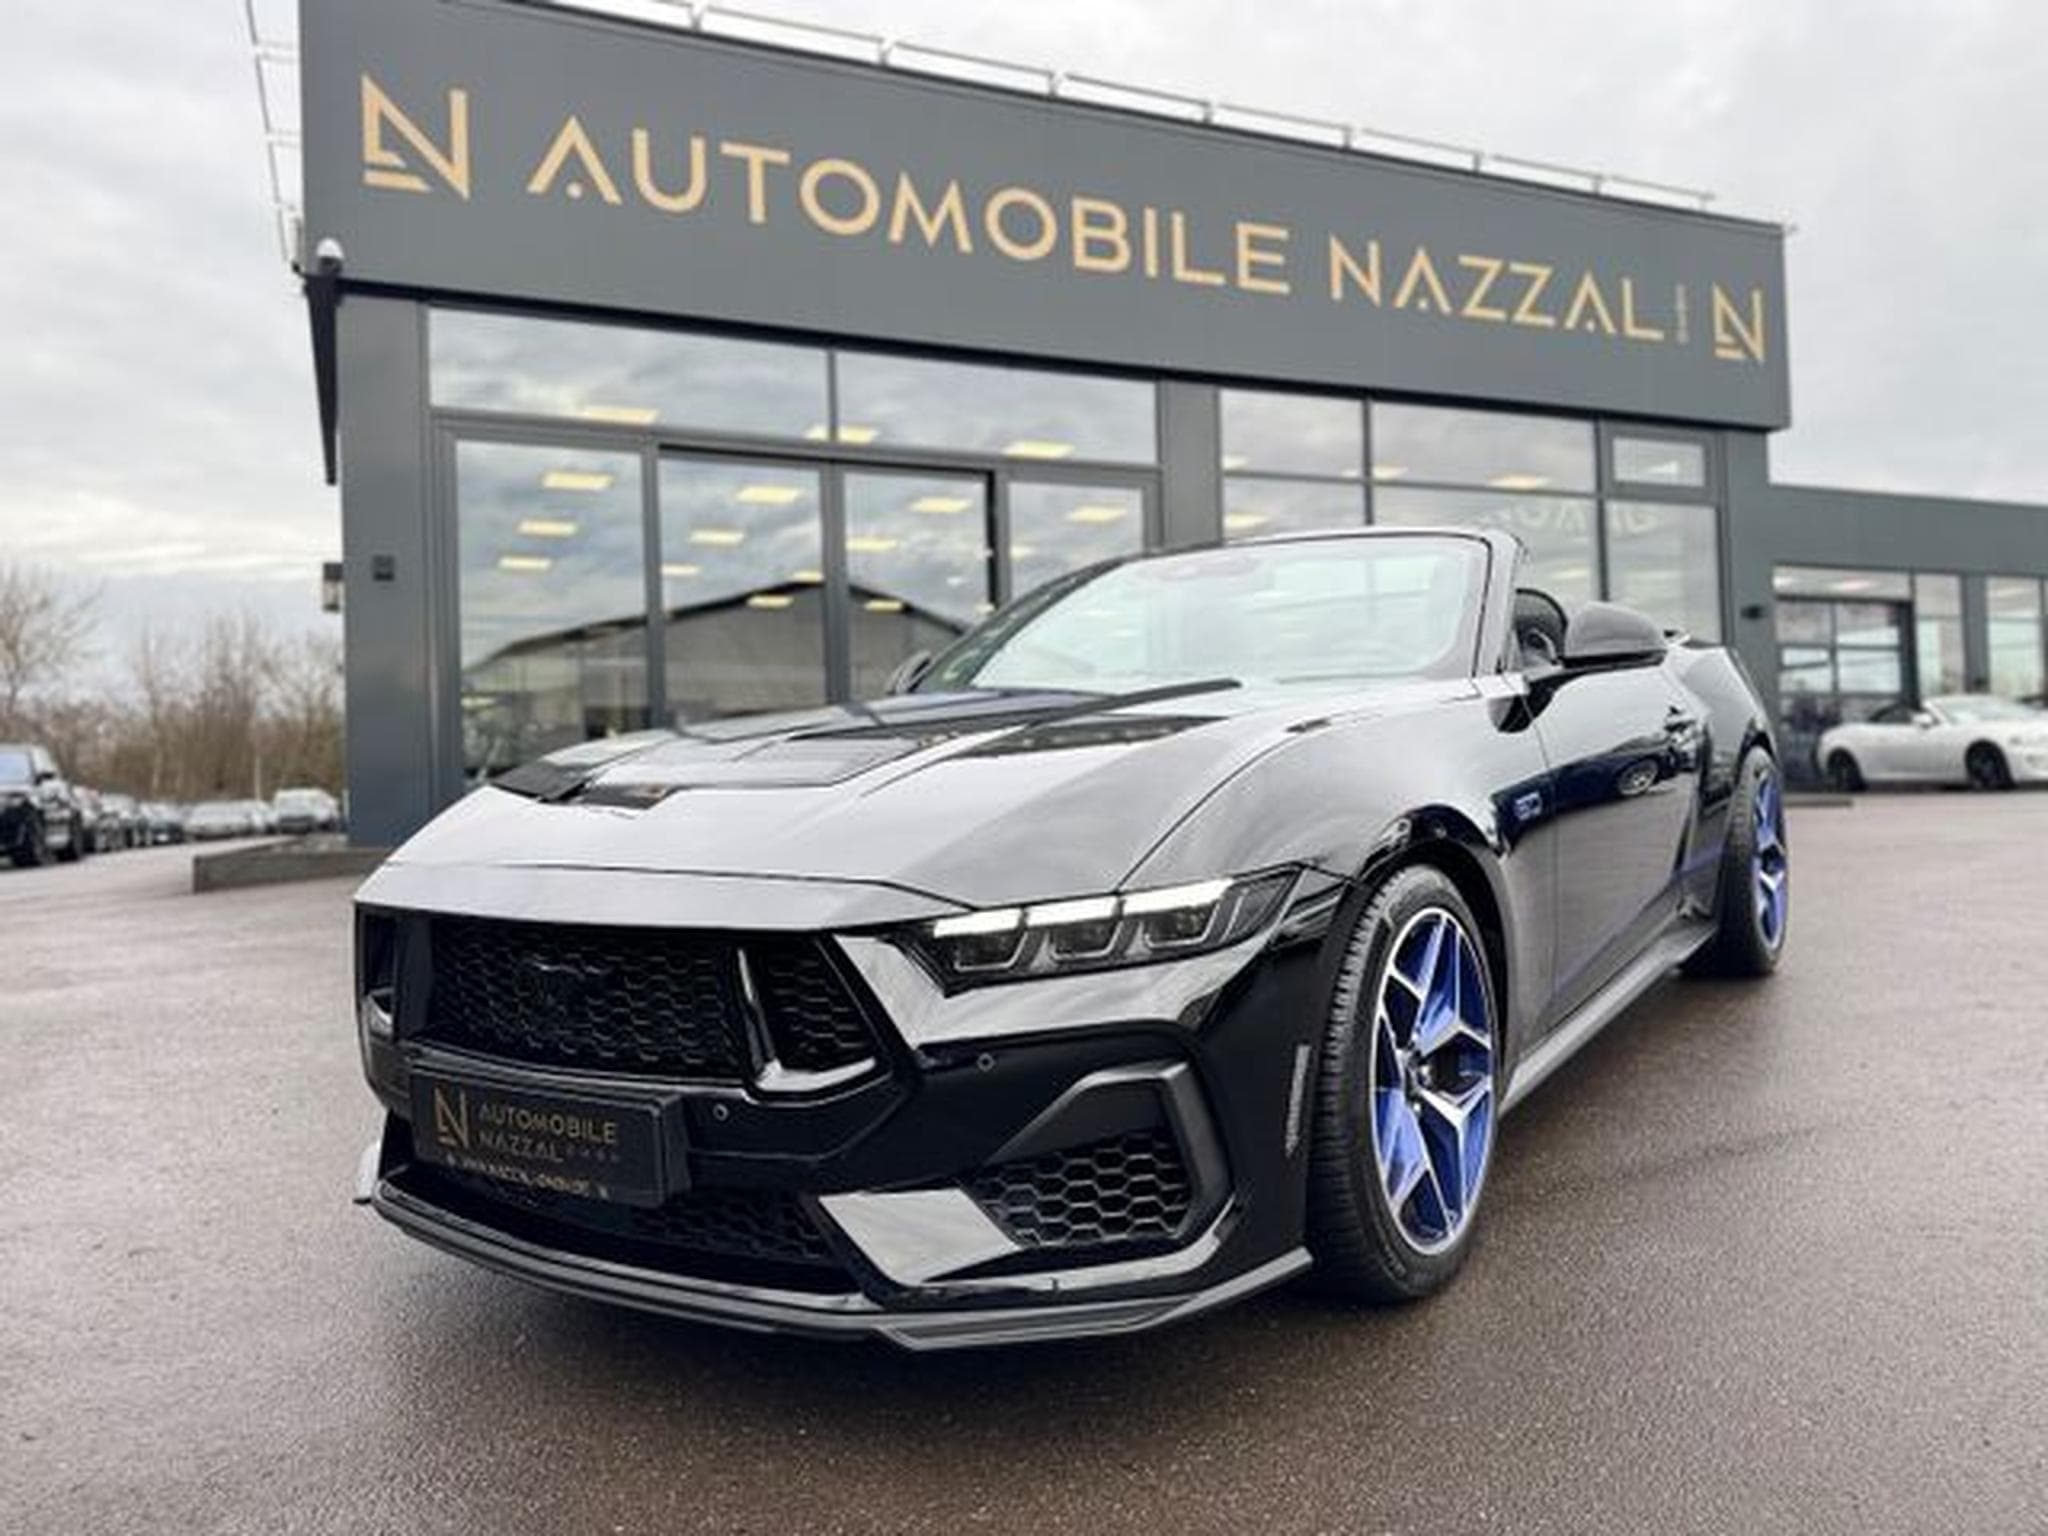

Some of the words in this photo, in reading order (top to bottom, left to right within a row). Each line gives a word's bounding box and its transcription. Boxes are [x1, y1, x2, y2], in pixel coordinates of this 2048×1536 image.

[527, 116, 1291, 294] AUTOMOBILE
[1328, 233, 1665, 341] NAZZAL
[479, 1103, 617, 1143] AUTOMOBILE
[478, 1132, 564, 1163] NAZZAL
